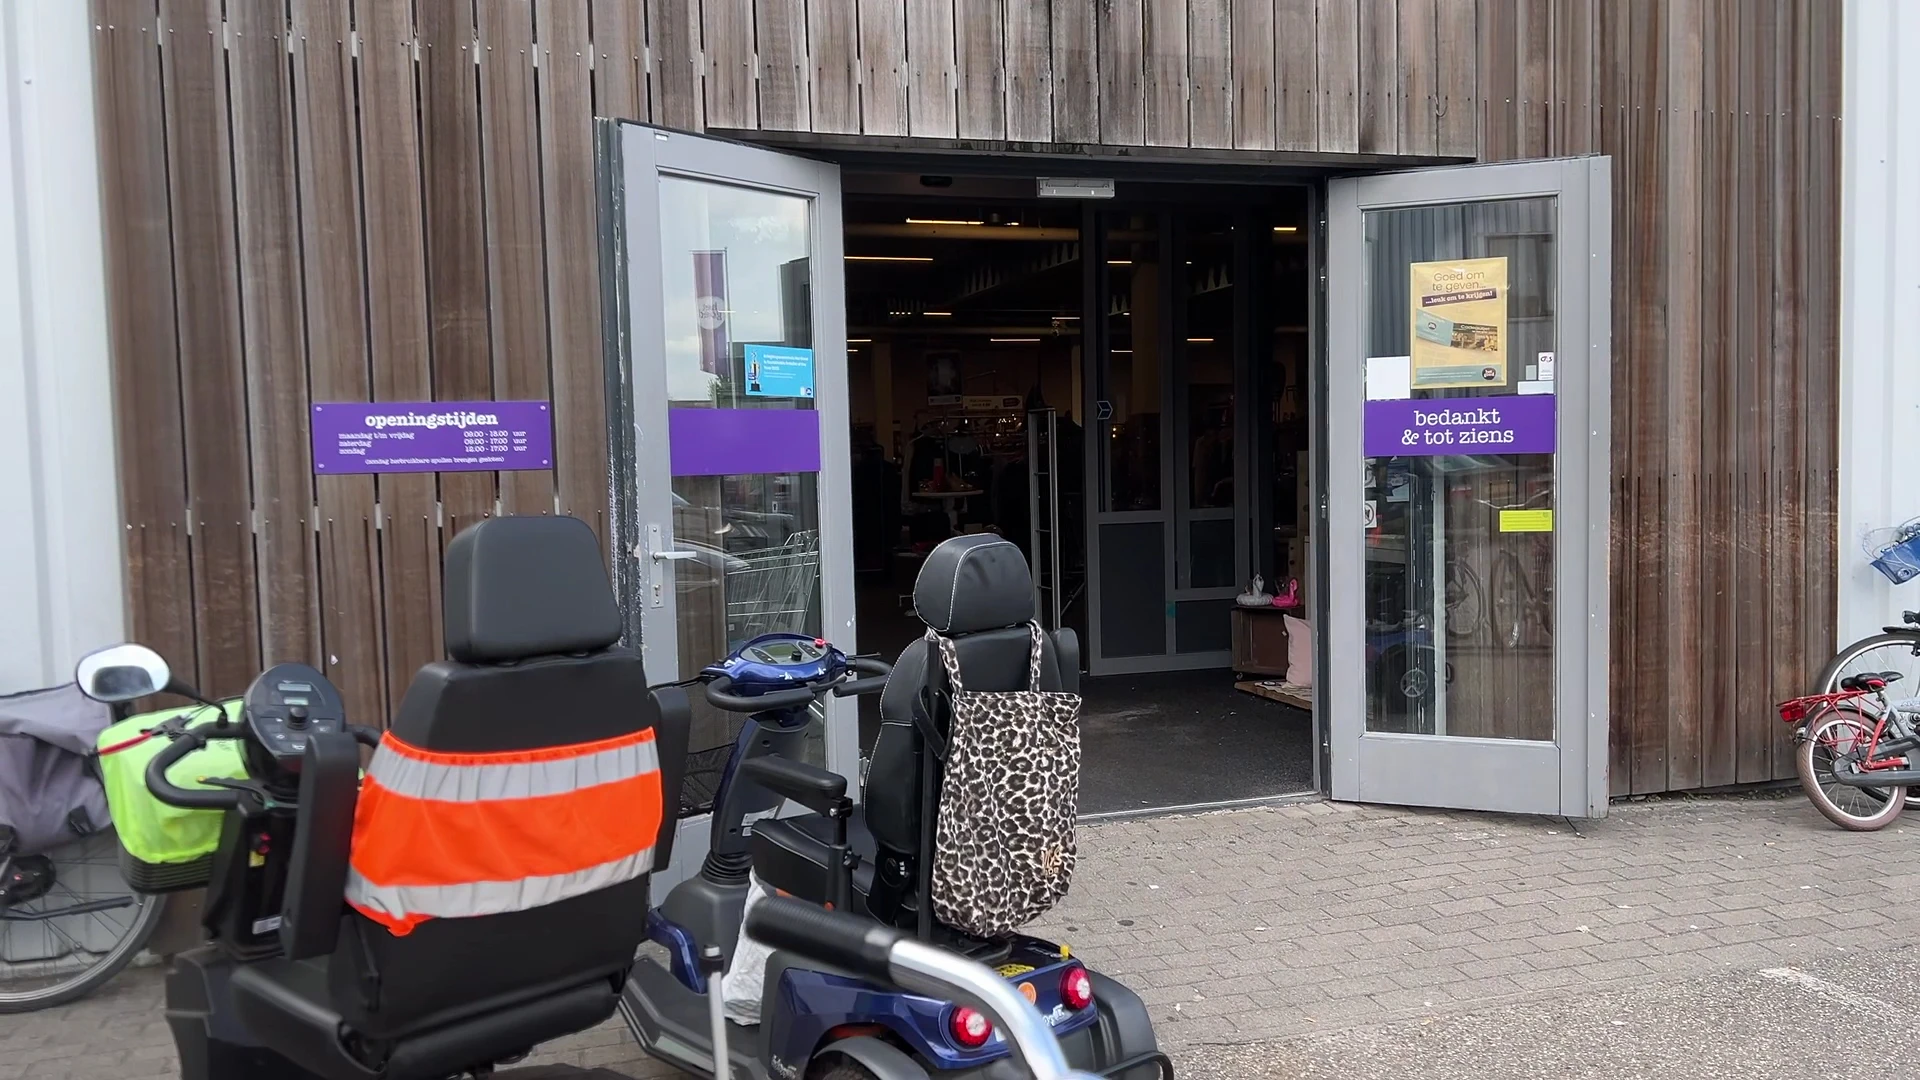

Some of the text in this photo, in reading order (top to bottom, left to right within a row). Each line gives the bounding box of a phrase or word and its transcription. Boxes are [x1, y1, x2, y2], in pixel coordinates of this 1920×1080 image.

[1434, 272, 1485, 281] Goed om
[1432, 283, 1443, 291] te
[1466, 291, 1493, 300] krijgen!
[364, 411, 499, 429] openingstijden
[1413, 408, 1501, 426] bedankt
[338, 432, 373, 440] maandag
[389, 431, 415, 440] vrijdag
[1401, 428, 1515, 446] & tot ziens
[338, 440, 372, 448] zaterdag
[339, 447, 366, 455] zondag
